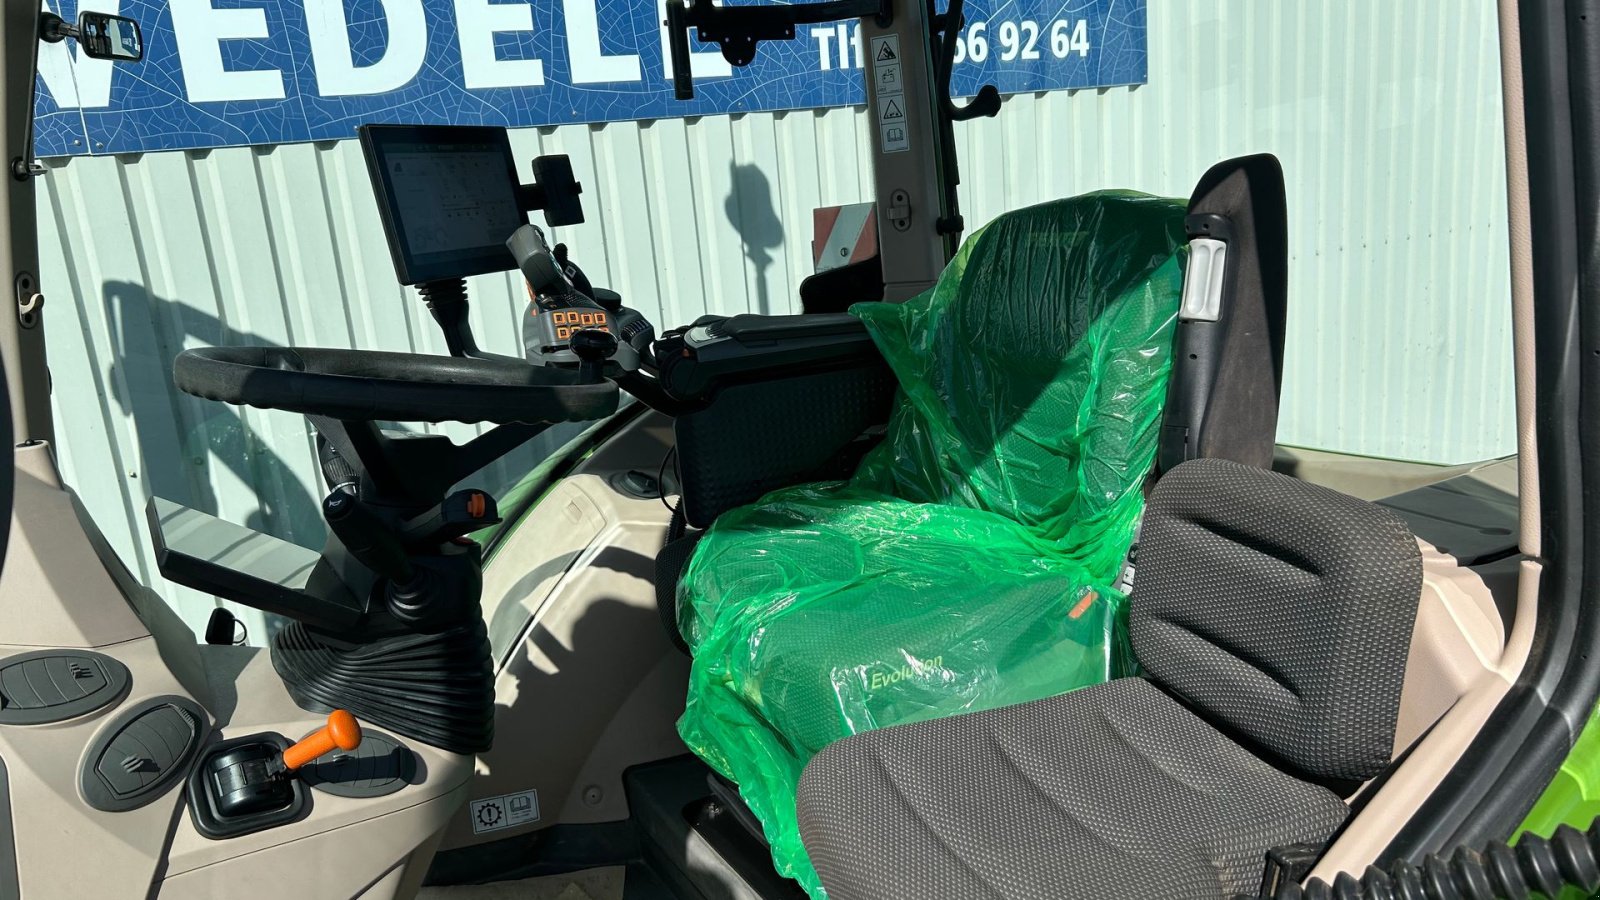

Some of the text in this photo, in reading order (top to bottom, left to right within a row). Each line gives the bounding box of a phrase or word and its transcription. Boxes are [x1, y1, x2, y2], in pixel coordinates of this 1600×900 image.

[999, 20, 1040, 61] 92
[1050, 19, 1090, 59] 64
[871, 655, 943, 690] Evoluion
